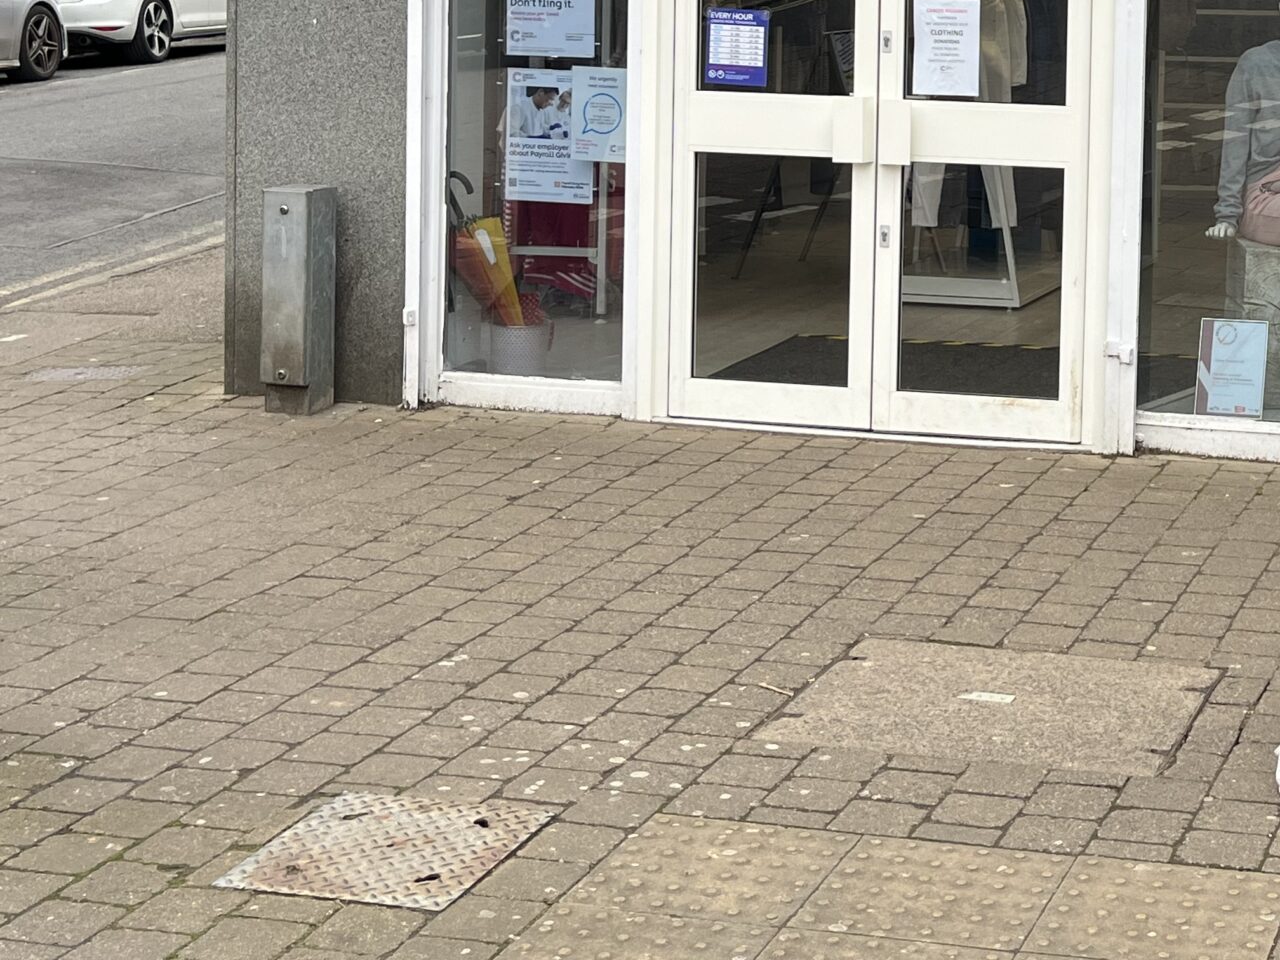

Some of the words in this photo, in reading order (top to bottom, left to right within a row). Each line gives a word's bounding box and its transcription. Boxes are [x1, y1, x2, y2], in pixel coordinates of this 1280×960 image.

[564, 0, 575, 9] it.
[537, 143, 569, 152] employer
[530, 150, 554, 159] Payroll
